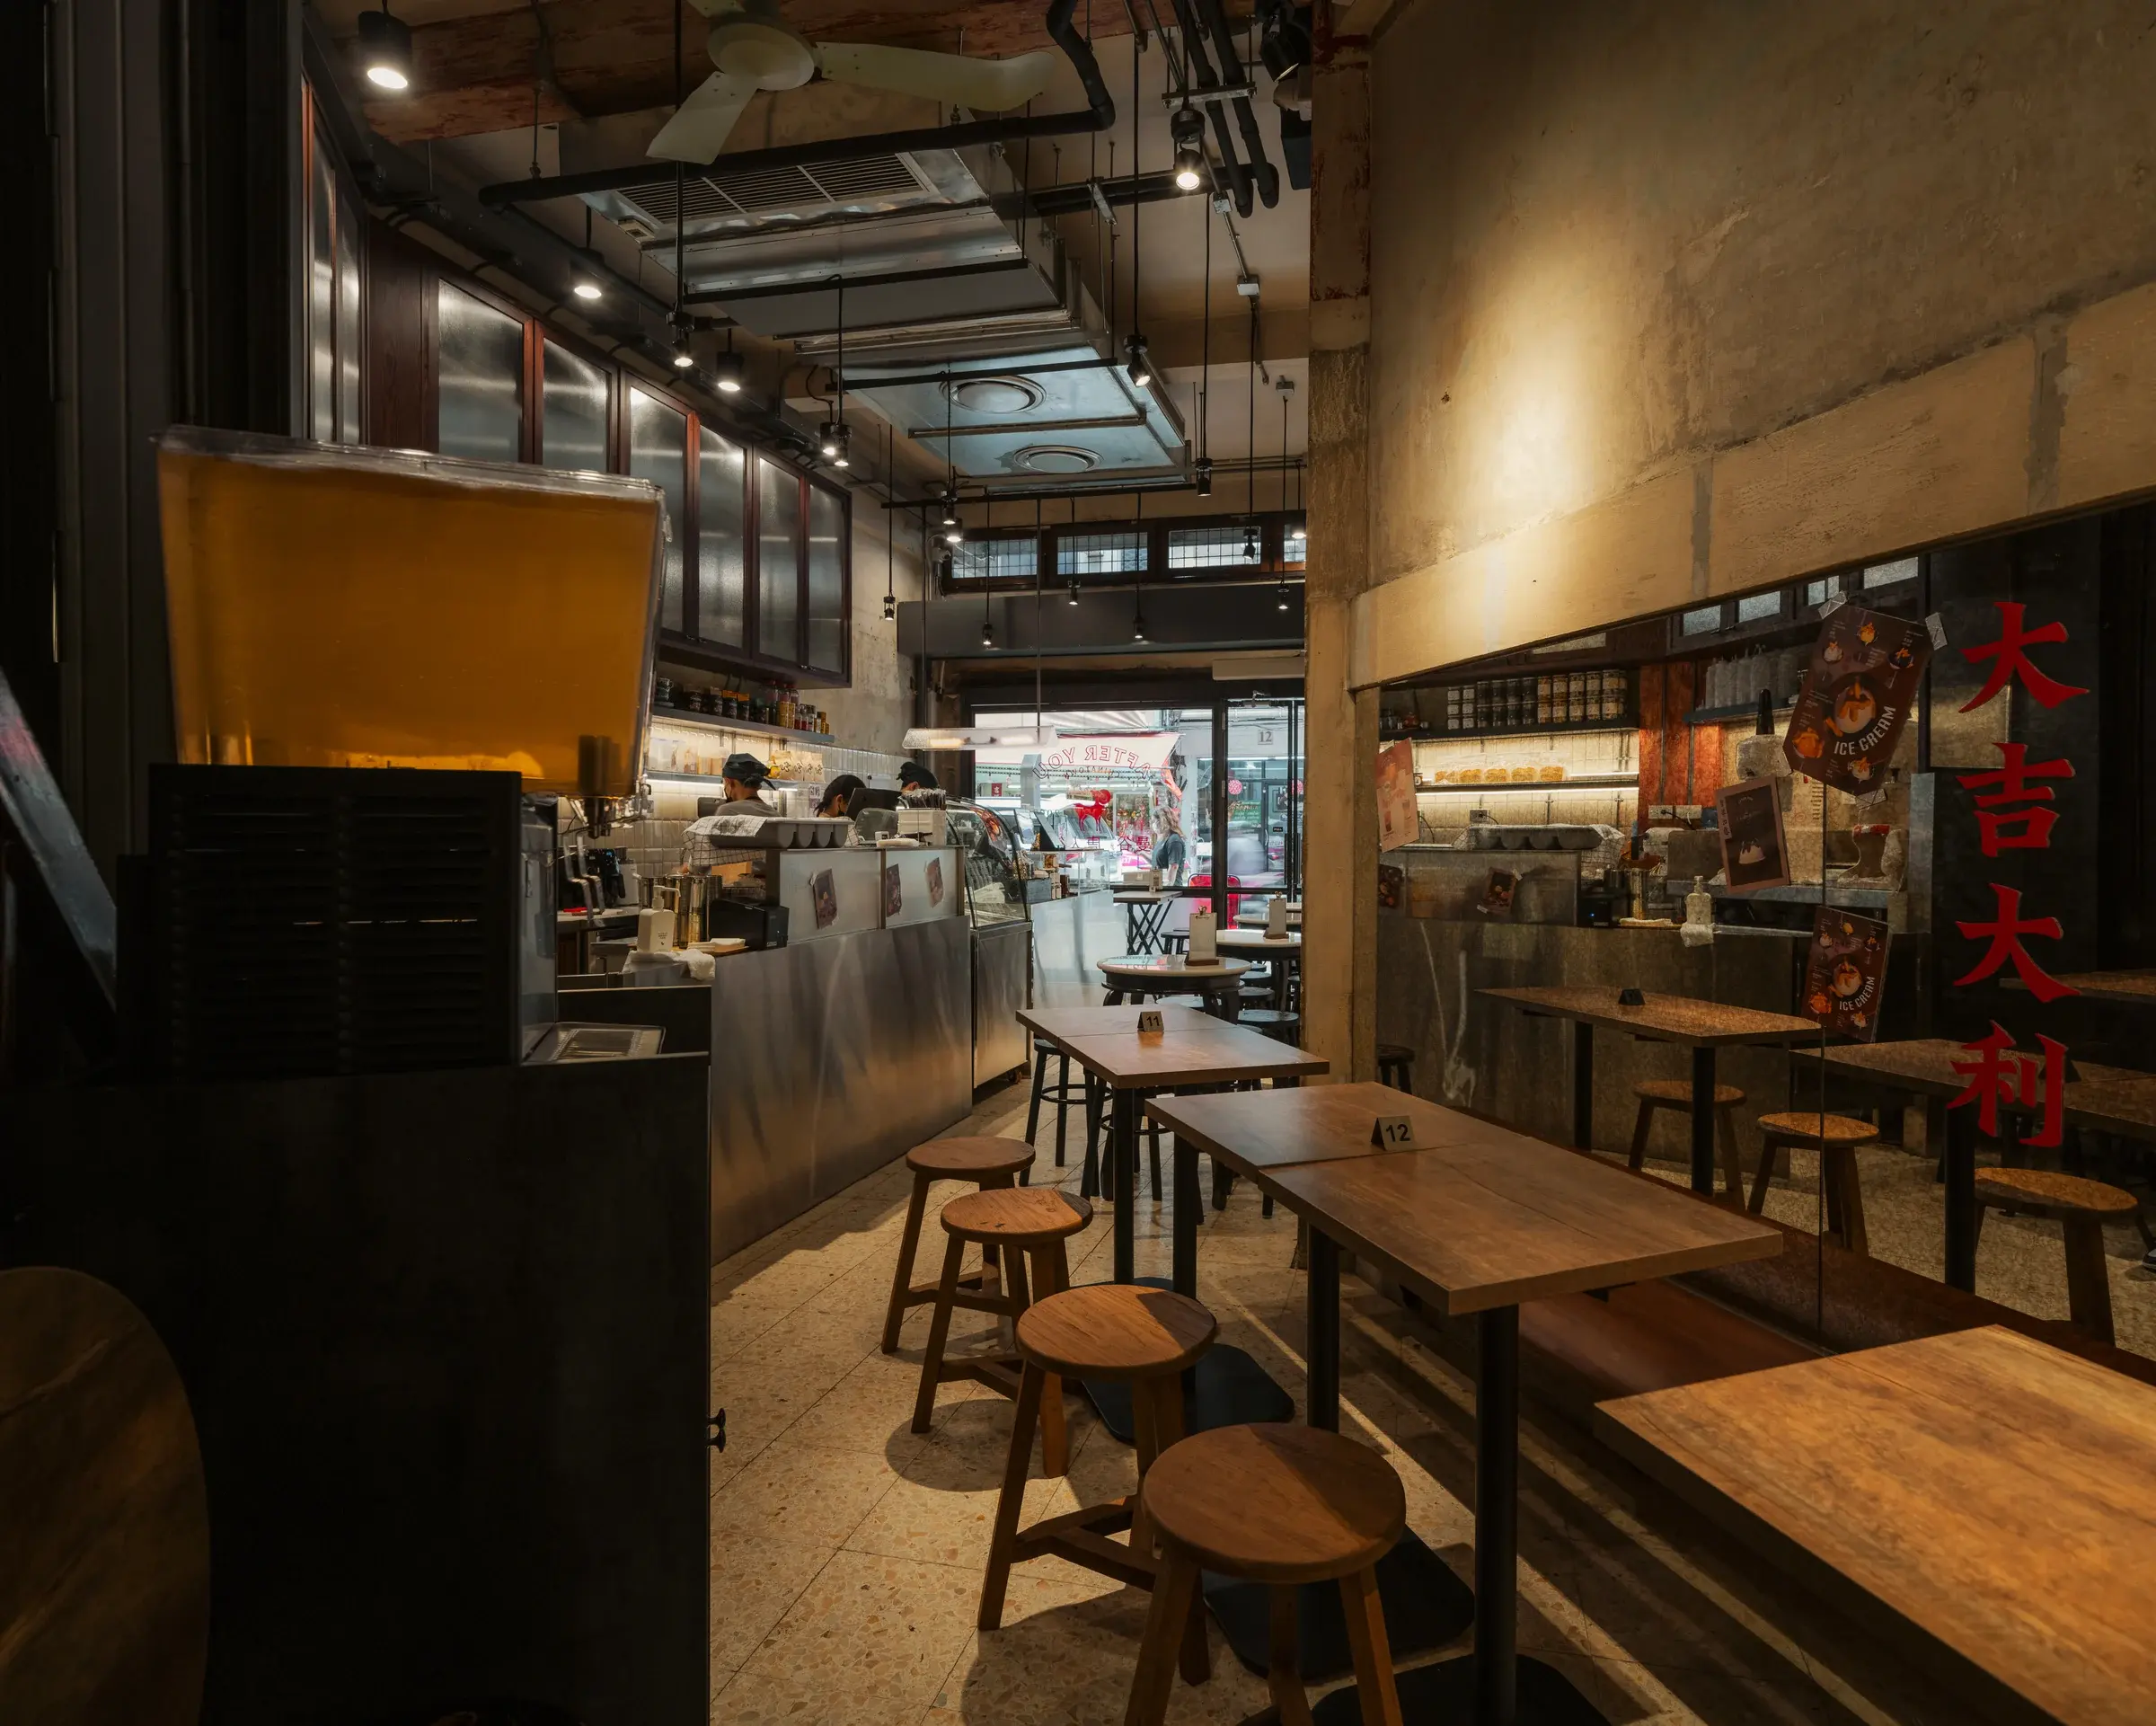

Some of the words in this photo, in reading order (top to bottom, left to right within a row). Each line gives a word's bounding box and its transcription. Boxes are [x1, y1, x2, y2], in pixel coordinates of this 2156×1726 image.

[1259, 730, 1272, 742] 12
[1833, 740, 1856, 756] ICE
[1859, 705, 1896, 752] CREAM
[1947, 601, 2090, 1148] 大吉大利
[1839, 1000, 1855, 1012] ICE
[1855, 976, 1876, 1008] CREAM
[1146, 1015, 1160, 1027] 11
[1385, 1123, 1410, 1143] 12
